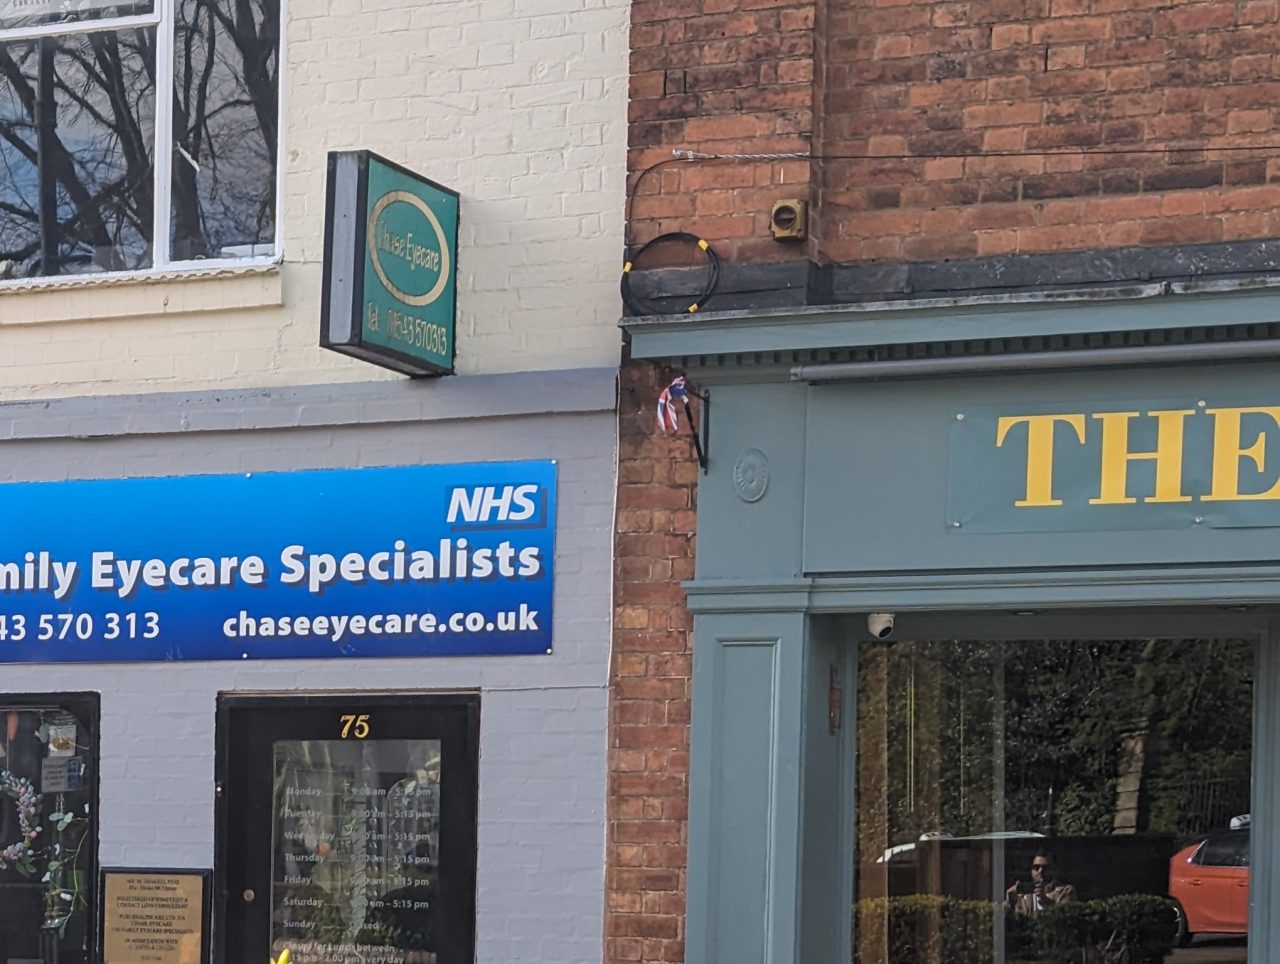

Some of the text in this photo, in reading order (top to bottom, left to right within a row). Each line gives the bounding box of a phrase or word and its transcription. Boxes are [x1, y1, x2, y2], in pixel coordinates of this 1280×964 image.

[406, 232, 439, 272] Eyecare
[996, 406, 1280, 507] THE
[446, 484, 538, 523] NHS
[91, 548, 266, 596] Eyecare
[280, 538, 541, 591] Specialists
[37, 612, 92, 641] 570
[104, 611, 160, 640] 313
[222, 604, 539, 641] chaseeyecare.co.uk
[340, 714, 370, 739] 75
[416, 788, 431, 798] pm
[416, 811, 431, 820] pm
[394, 832, 414, 841] 5:15
[415, 833, 431, 843] pm
[284, 854, 325, 864] Thursday
[415, 856, 430, 865] pm
[284, 875, 312, 886] Friday
[414, 878, 430, 888] pm
[283, 896, 323, 907] Saturday
[393, 899, 412, 908] 5:15
[414, 901, 429, 910] pm
[283, 919, 316, 929] Sunday
[356, 943, 395, 953] between
